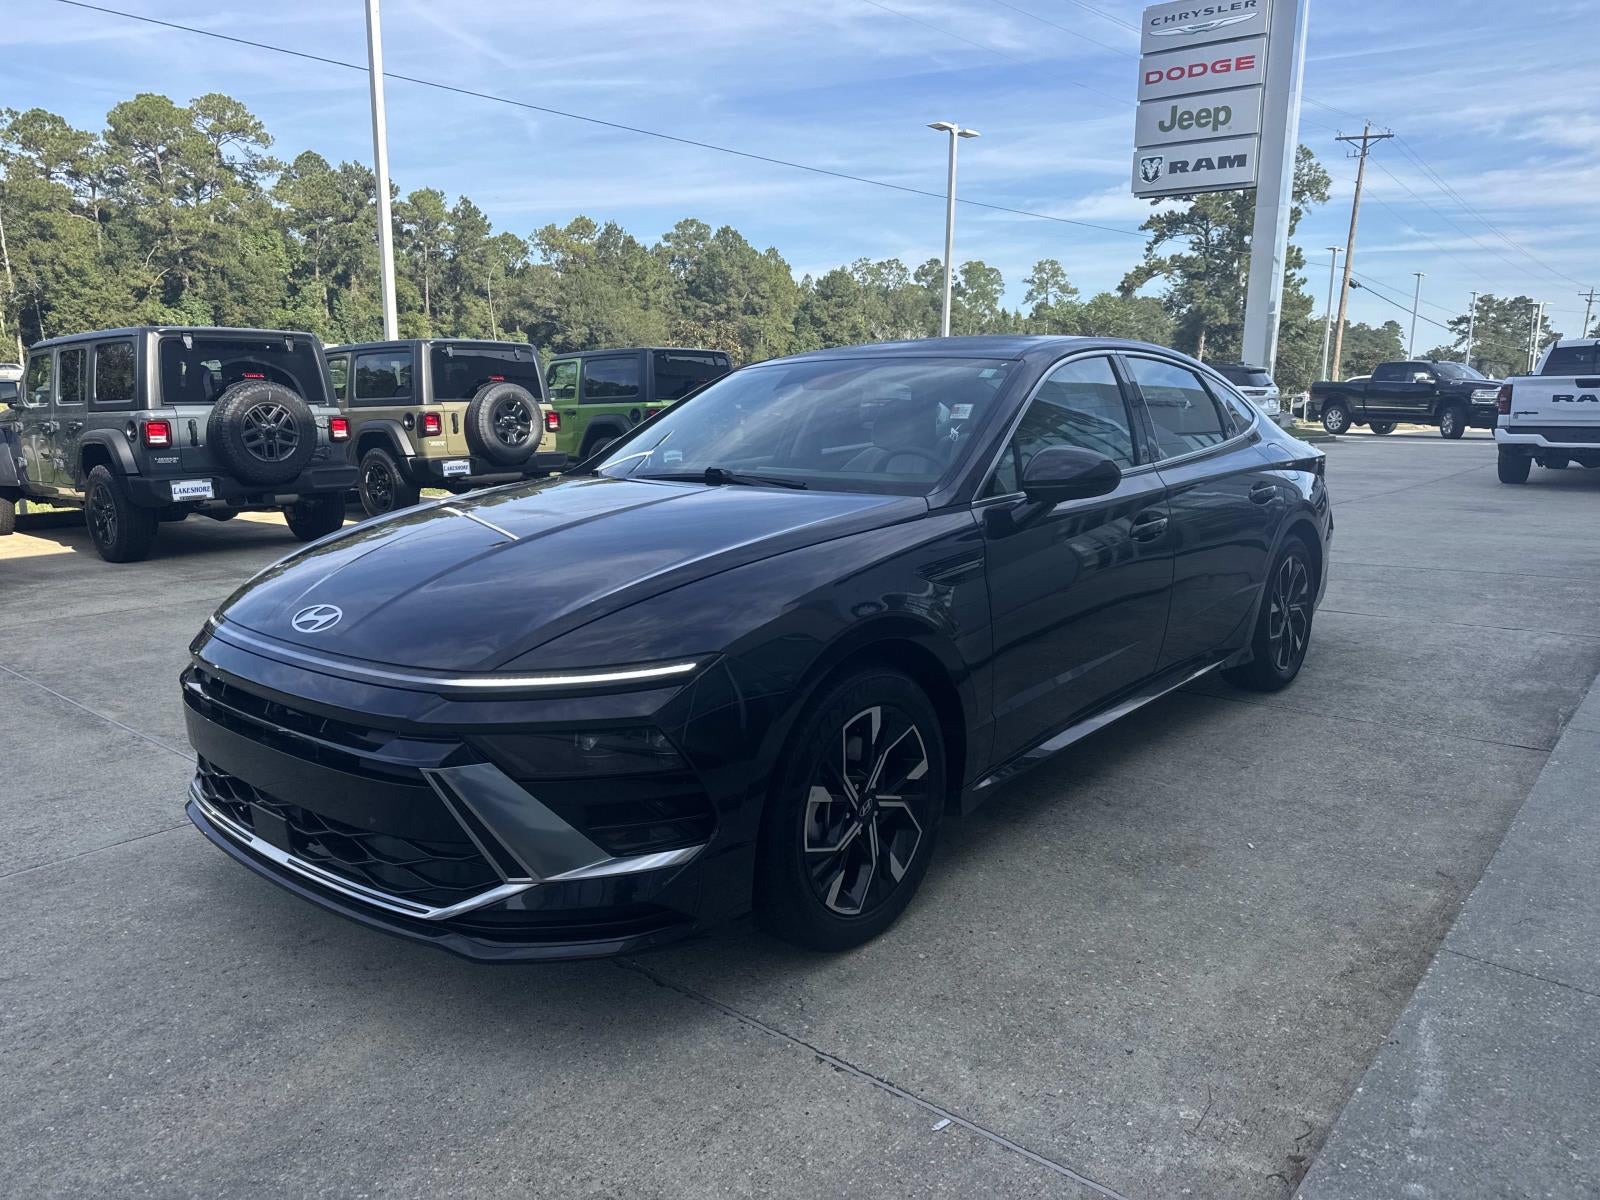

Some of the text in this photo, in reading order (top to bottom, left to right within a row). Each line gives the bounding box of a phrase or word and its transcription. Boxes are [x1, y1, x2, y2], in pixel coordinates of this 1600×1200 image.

[1150, 0, 1257, 26] CHRYSLER
[1145, 55, 1256, 85] DODGE
[1158, 105, 1232, 133] Jeep
[1168, 154, 1247, 175] RAM
[173, 485, 211, 495] LAKESHORE
